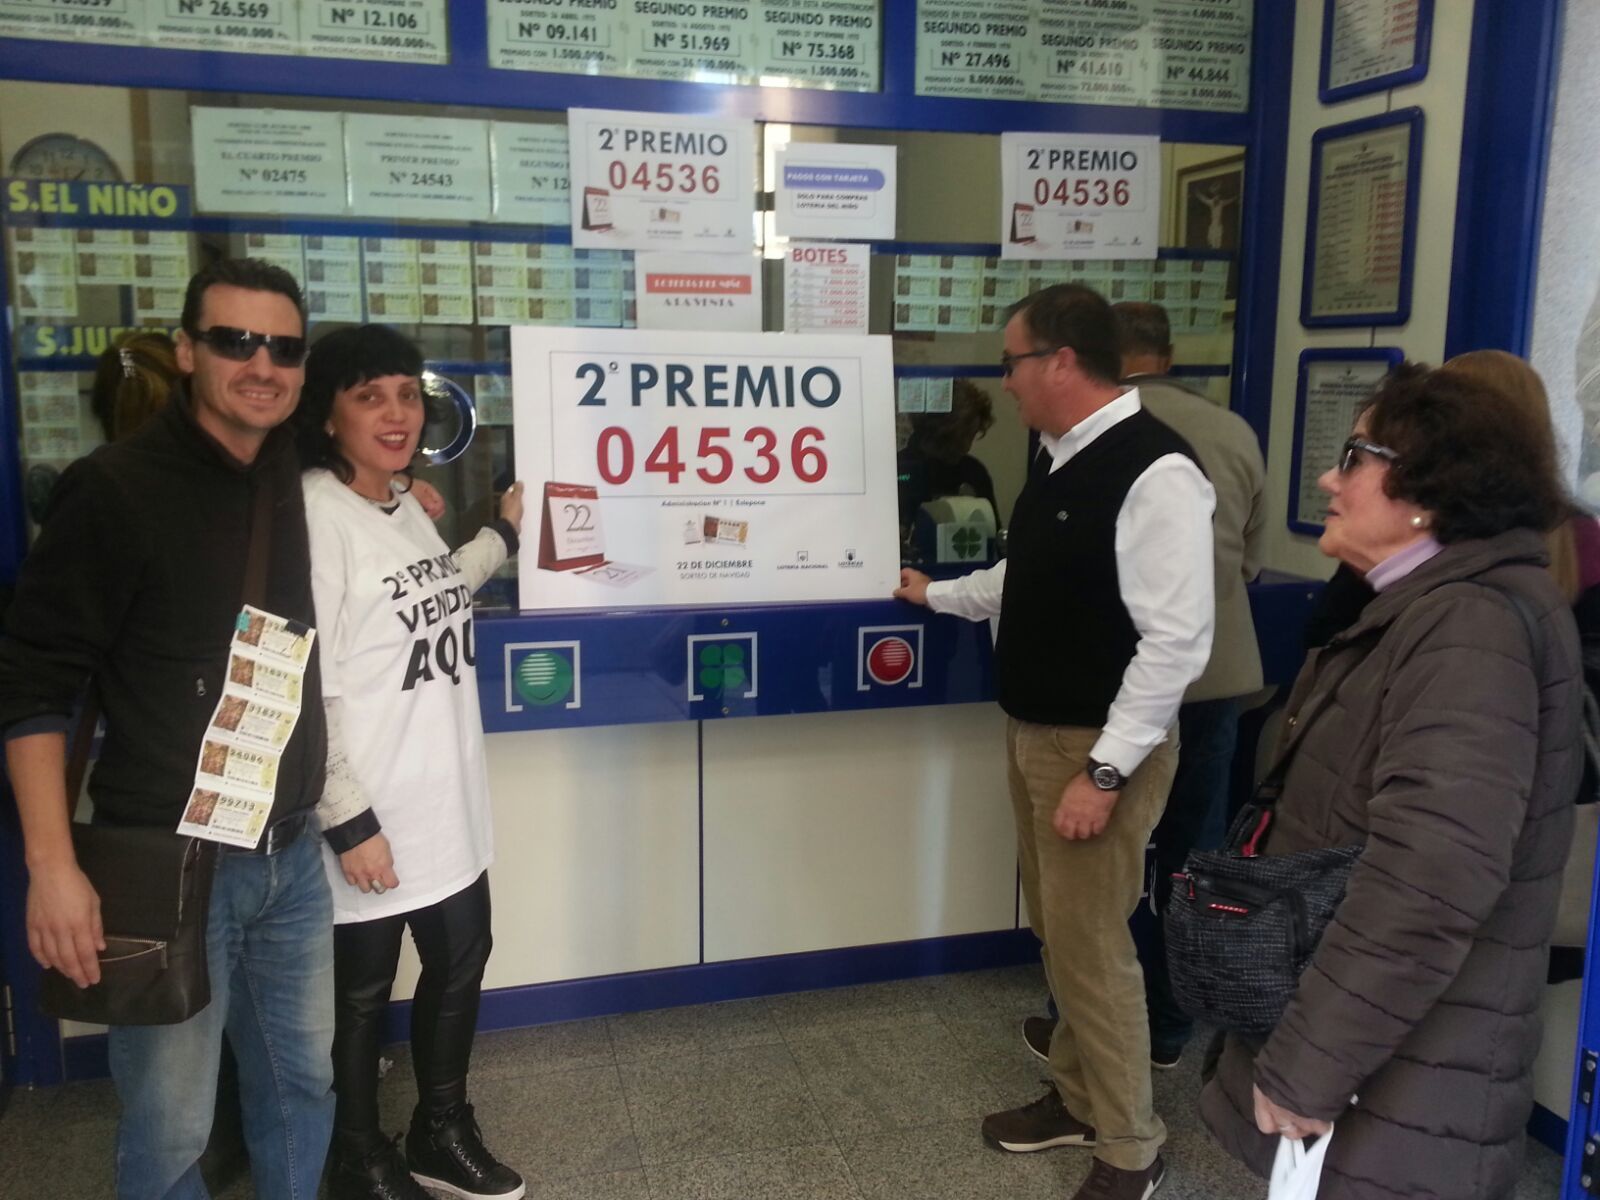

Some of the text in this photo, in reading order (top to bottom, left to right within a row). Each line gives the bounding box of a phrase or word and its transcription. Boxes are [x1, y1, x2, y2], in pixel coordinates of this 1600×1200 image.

[210, 1, 269, 18] 26.569
[331, 8, 417, 29] Nº 12.106
[634, 1, 748, 20] SEGUNDO PREMIO
[764, 10, 873, 29] SEGUNDO PREMIO
[519, 22, 596, 41] Nº 09.141
[924, 21, 1028, 38] SEGUNDO PREMIO
[653, 32, 731, 51] Nº 51.969
[783, 41, 855, 60] Nº 75.368
[1041, 33, 1095, 49] SEGUNDO
[1207, 41, 1246, 56] PREMIO
[941, 51, 1011, 69] Nº 27.496
[1056, 59, 1076, 75] Nº
[1167, 66, 1185, 80] Nº
[625, 129, 728, 156] PREMIO
[1049, 149, 1138, 172] PREMIO
[262, 169, 307, 183] 02475
[411, 172, 454, 187] 24543
[608, 160, 720, 194] 04536
[8, 180, 177, 217] S.EL NIÑO
[1034, 178, 1130, 207] 04536
[792, 248, 848, 264] BOTES
[631, 363, 841, 408] PREMIO
[597, 425, 828, 486] 04536
[564, 504, 595, 532] 22
[677, 560, 753, 570] 22 DE DICIEMBRE
[680, 572, 708, 580] SORTEO
[720, 571, 750, 579] NAVIDAD
[401, 618, 475, 692] AQU
